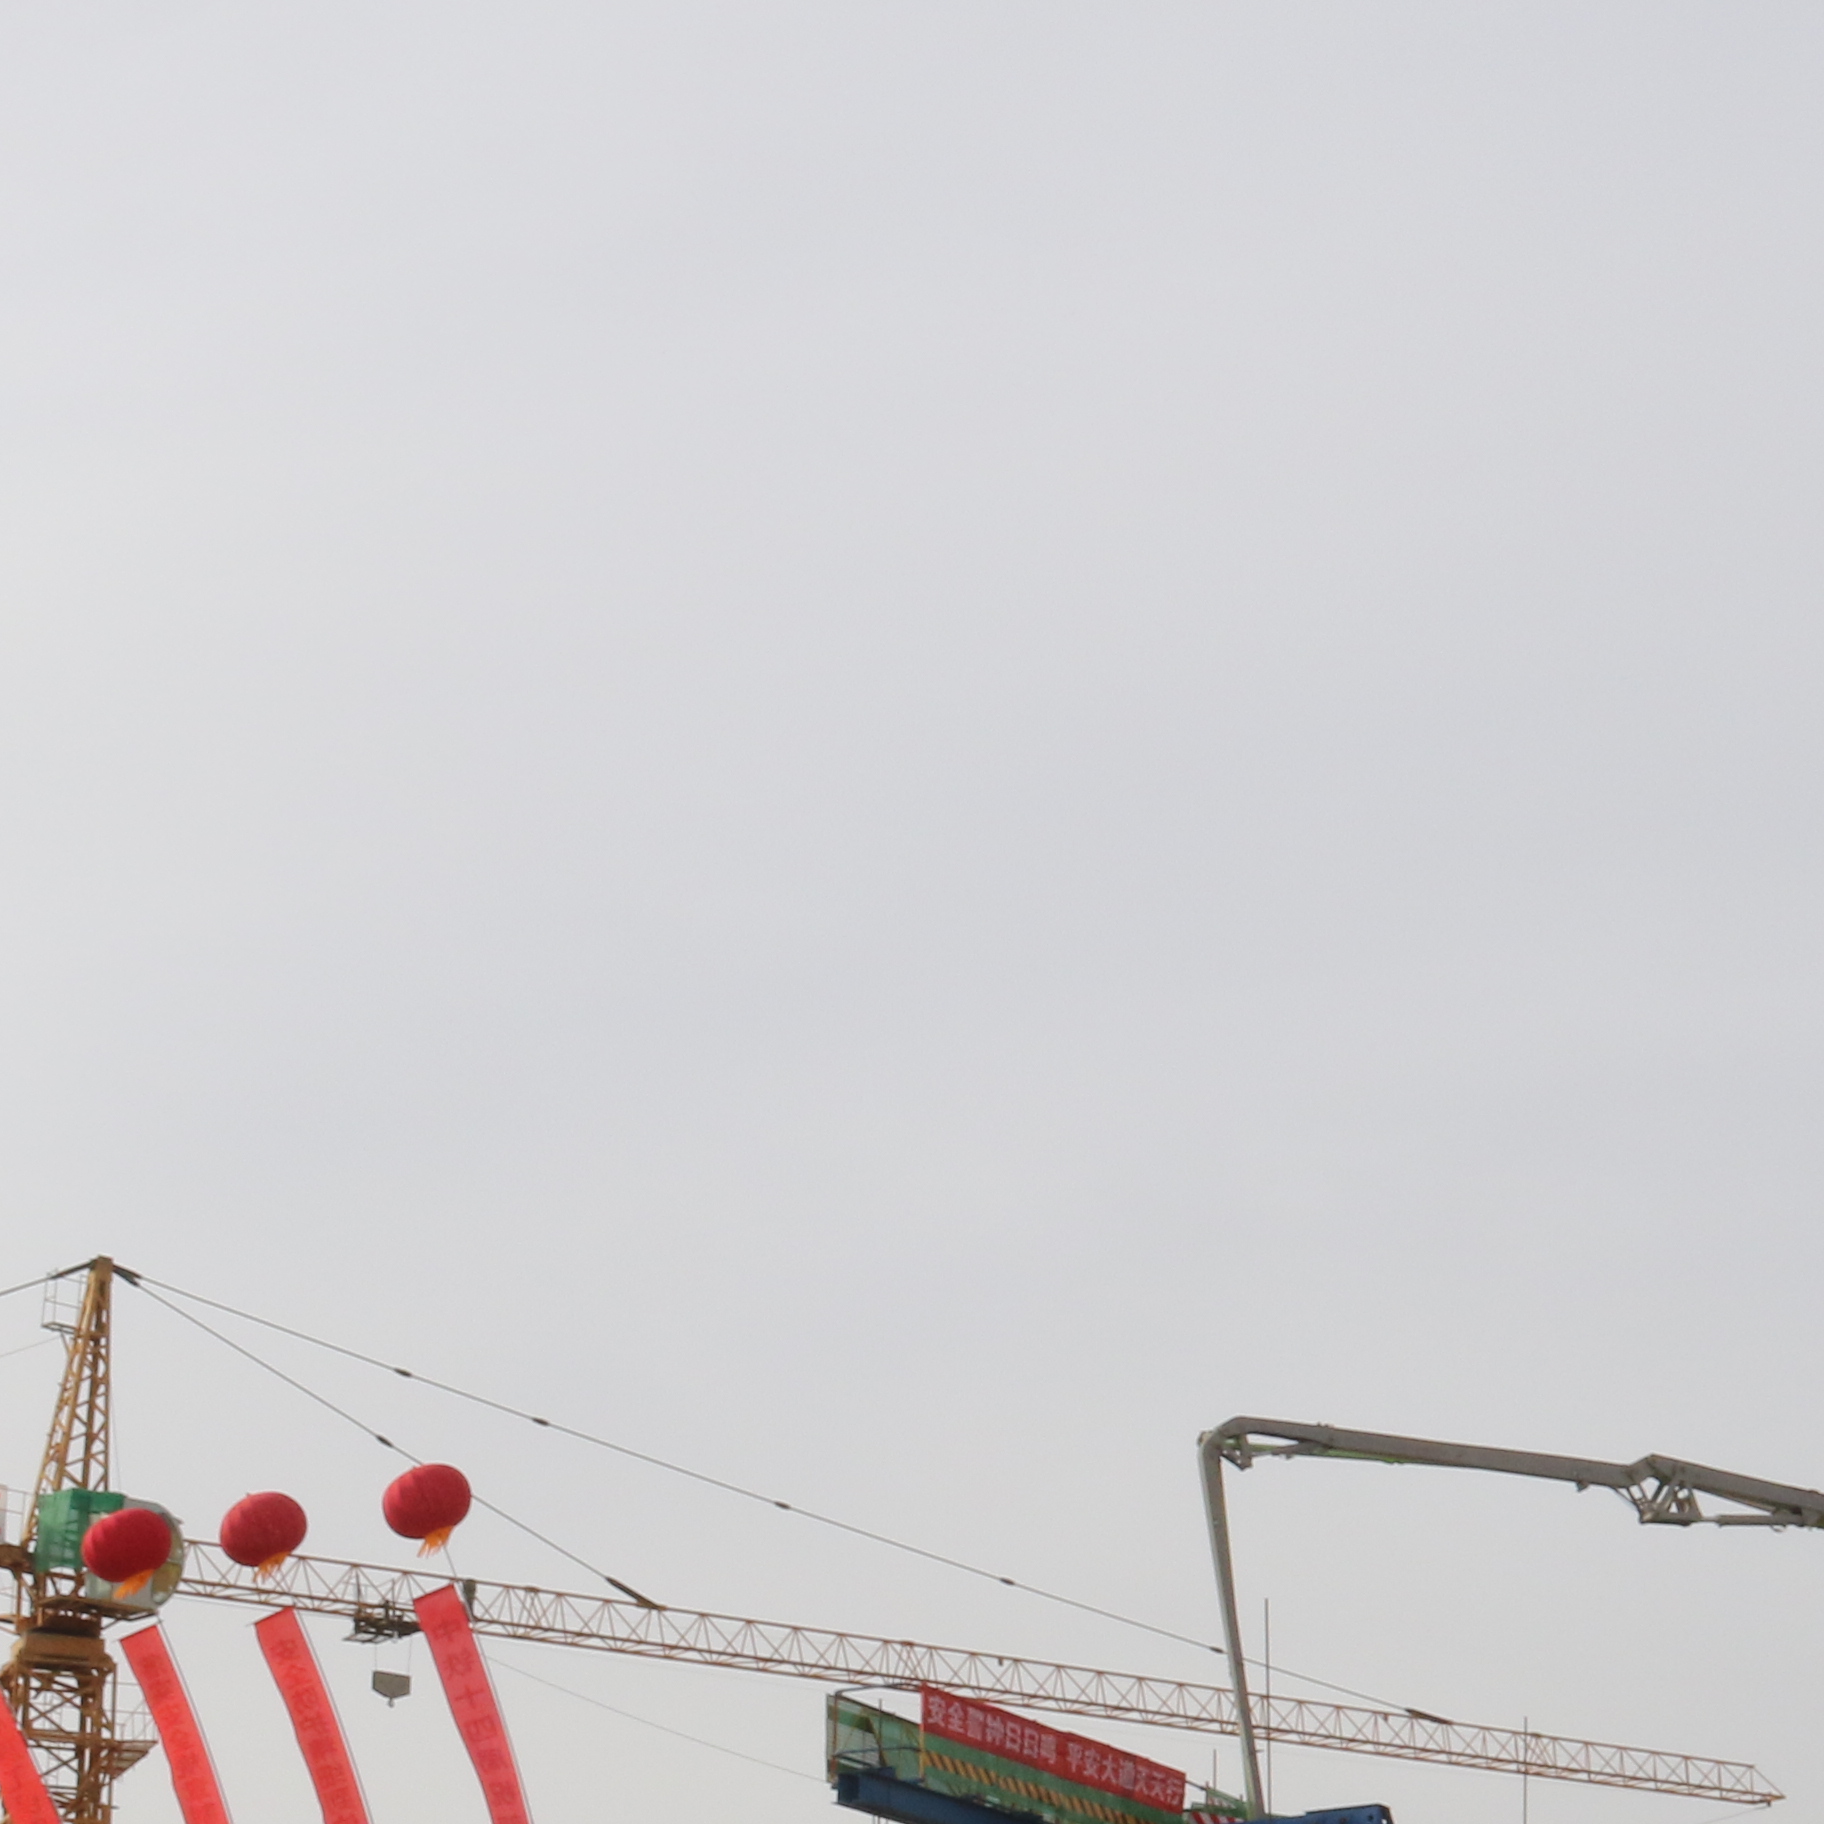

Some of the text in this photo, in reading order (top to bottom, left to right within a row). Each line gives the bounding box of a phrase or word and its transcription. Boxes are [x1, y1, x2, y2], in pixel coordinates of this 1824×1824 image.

[928, 1694, 1057, 1766] 安全警钟日日鸣
